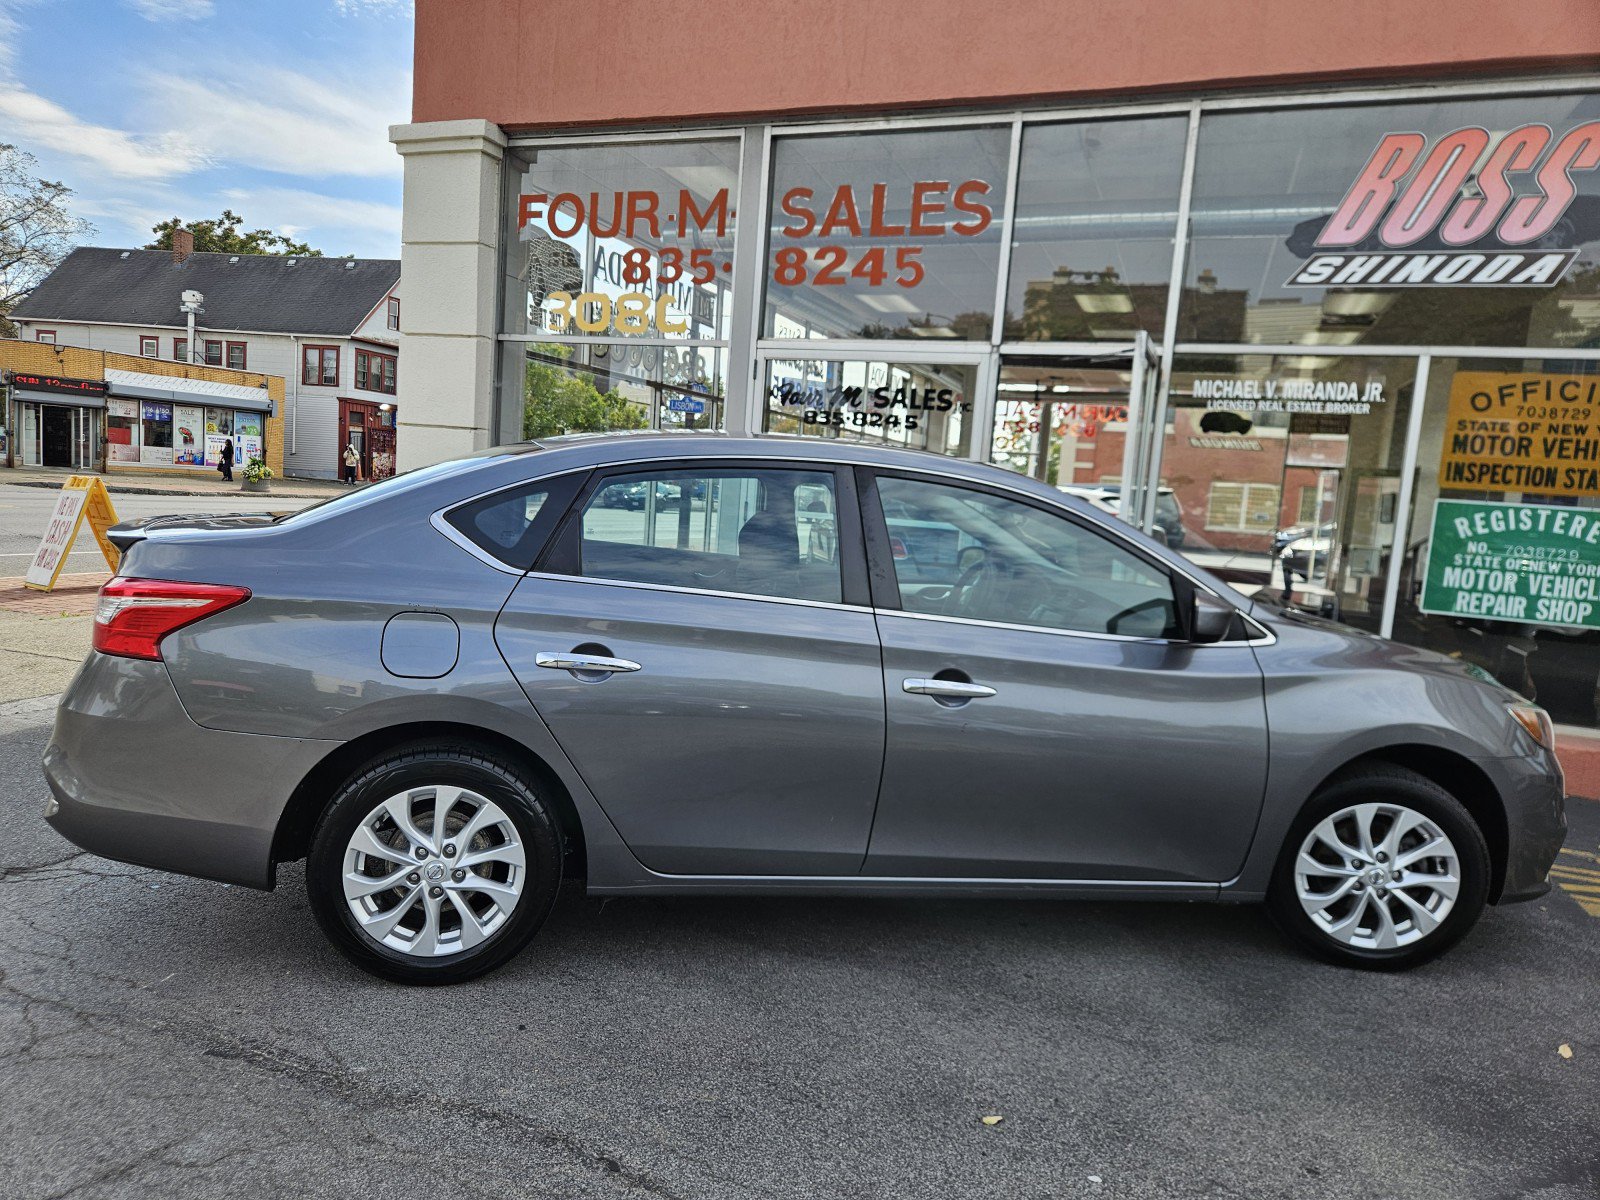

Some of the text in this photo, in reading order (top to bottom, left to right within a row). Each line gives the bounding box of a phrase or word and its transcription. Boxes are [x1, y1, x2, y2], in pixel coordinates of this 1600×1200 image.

[1312, 119, 1600, 248] BOSS
[781, 179, 993, 238] SALES
[774, 246, 925, 288] 8245
[1294, 253, 1566, 284] SHINODA
[874, 386, 953, 412] SALES
[1192, 379, 1386, 402] MICHAEL V. MIRANDA JR.
[1470, 379, 1600, 412] OFFICI
[1206, 399, 1371, 414] LICENSED REAL ESTATE BROKER
[1516, 405, 1591, 420] 7038729
[1457, 419, 1510, 432] STATE
[1517, 421, 1542, 434] OF
[1548, 423, 1589, 436] NEW
[1452, 433, 1600, 461] MOTOR VEHI
[1445, 461, 1600, 490] INSPECTION STA
[1467, 540, 1493, 555] NO.
[1453, 554, 1502, 570] STATE
[1505, 558, 1521, 571] OF
[1528, 560, 1562, 575] NEW
[1442, 566, 1600, 601] MOTOR VEHICL
[1455, 590, 1593, 624] REPAIR SHOP
